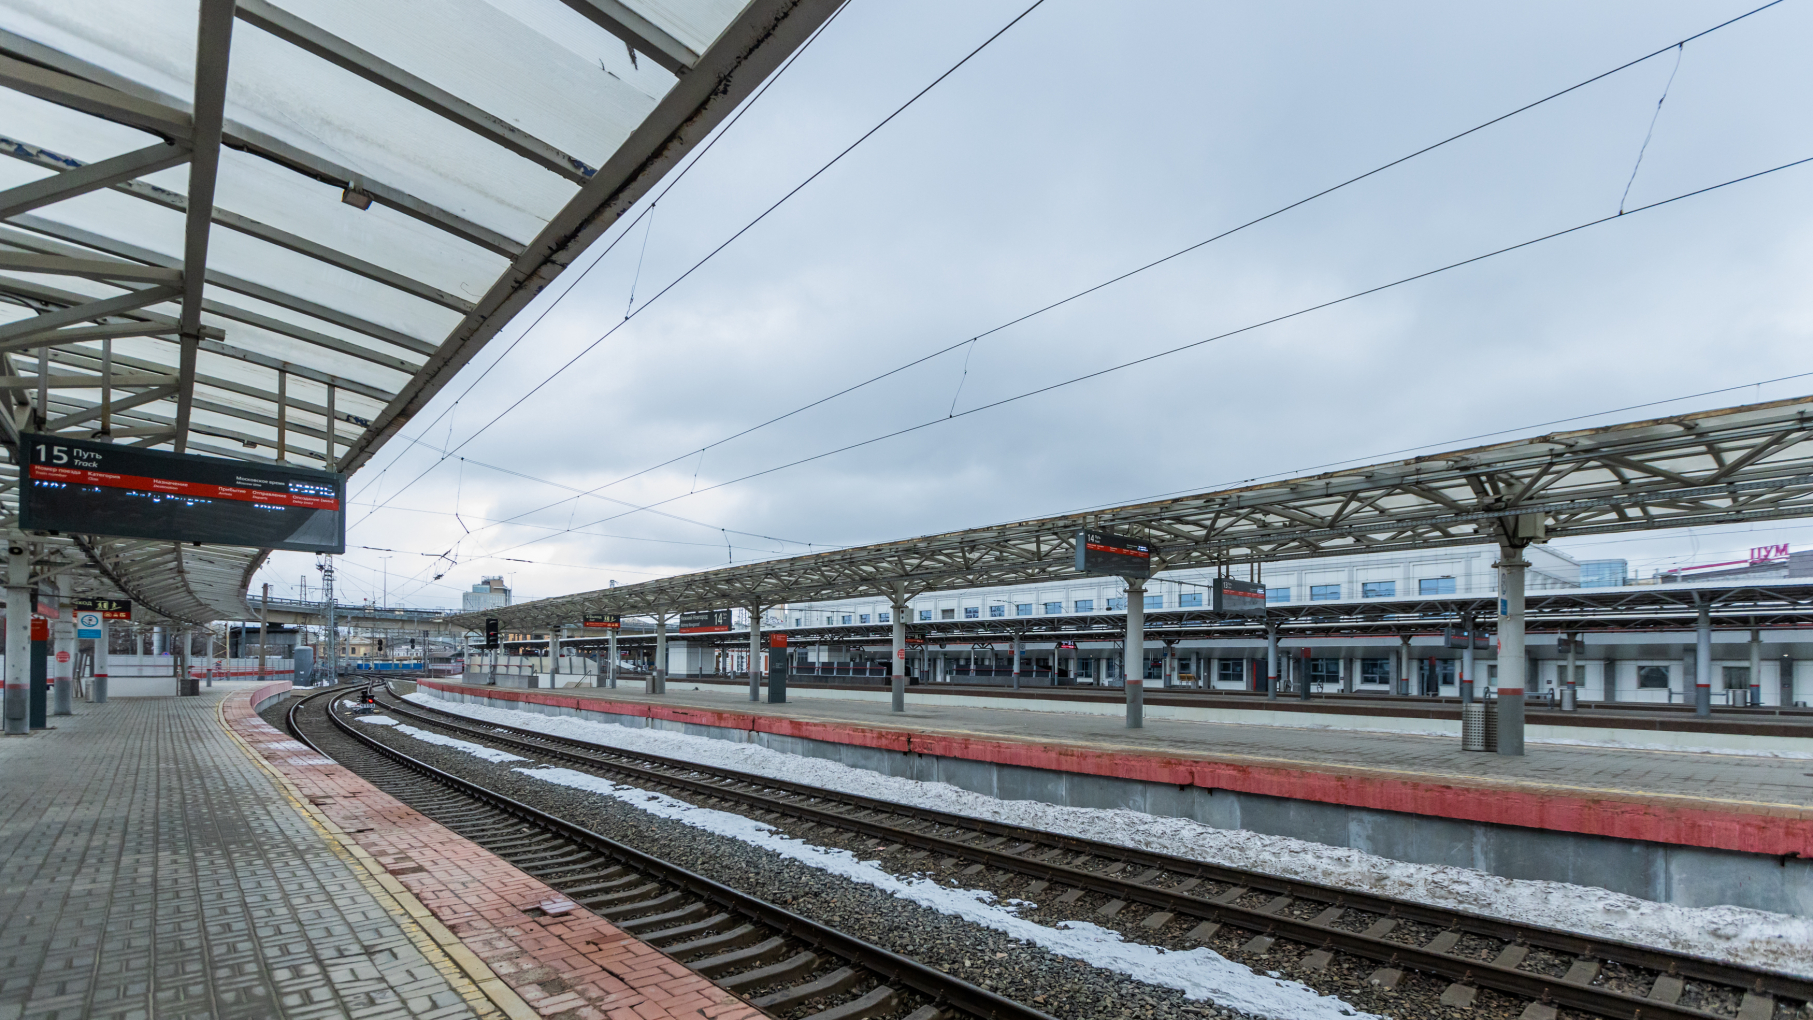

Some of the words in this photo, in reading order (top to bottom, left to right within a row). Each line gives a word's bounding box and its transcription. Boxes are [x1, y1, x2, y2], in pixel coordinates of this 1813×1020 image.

[36, 444, 69, 464] 15
[73, 448, 103, 459] Путь
[74, 459, 98, 468] Track
[58, 467, 82, 475] поезда
[87, 471, 121, 479] Категория
[153, 479, 188, 487] Назначение
[236, 475, 269, 484] Московское
[218, 486, 247, 494] Прибытие
[252, 490, 287, 498] Отправление
[1088, 534, 1094, 542] 14
[1750, 543, 1790, 561] ЦУМ
[714, 613, 722, 625] 14
